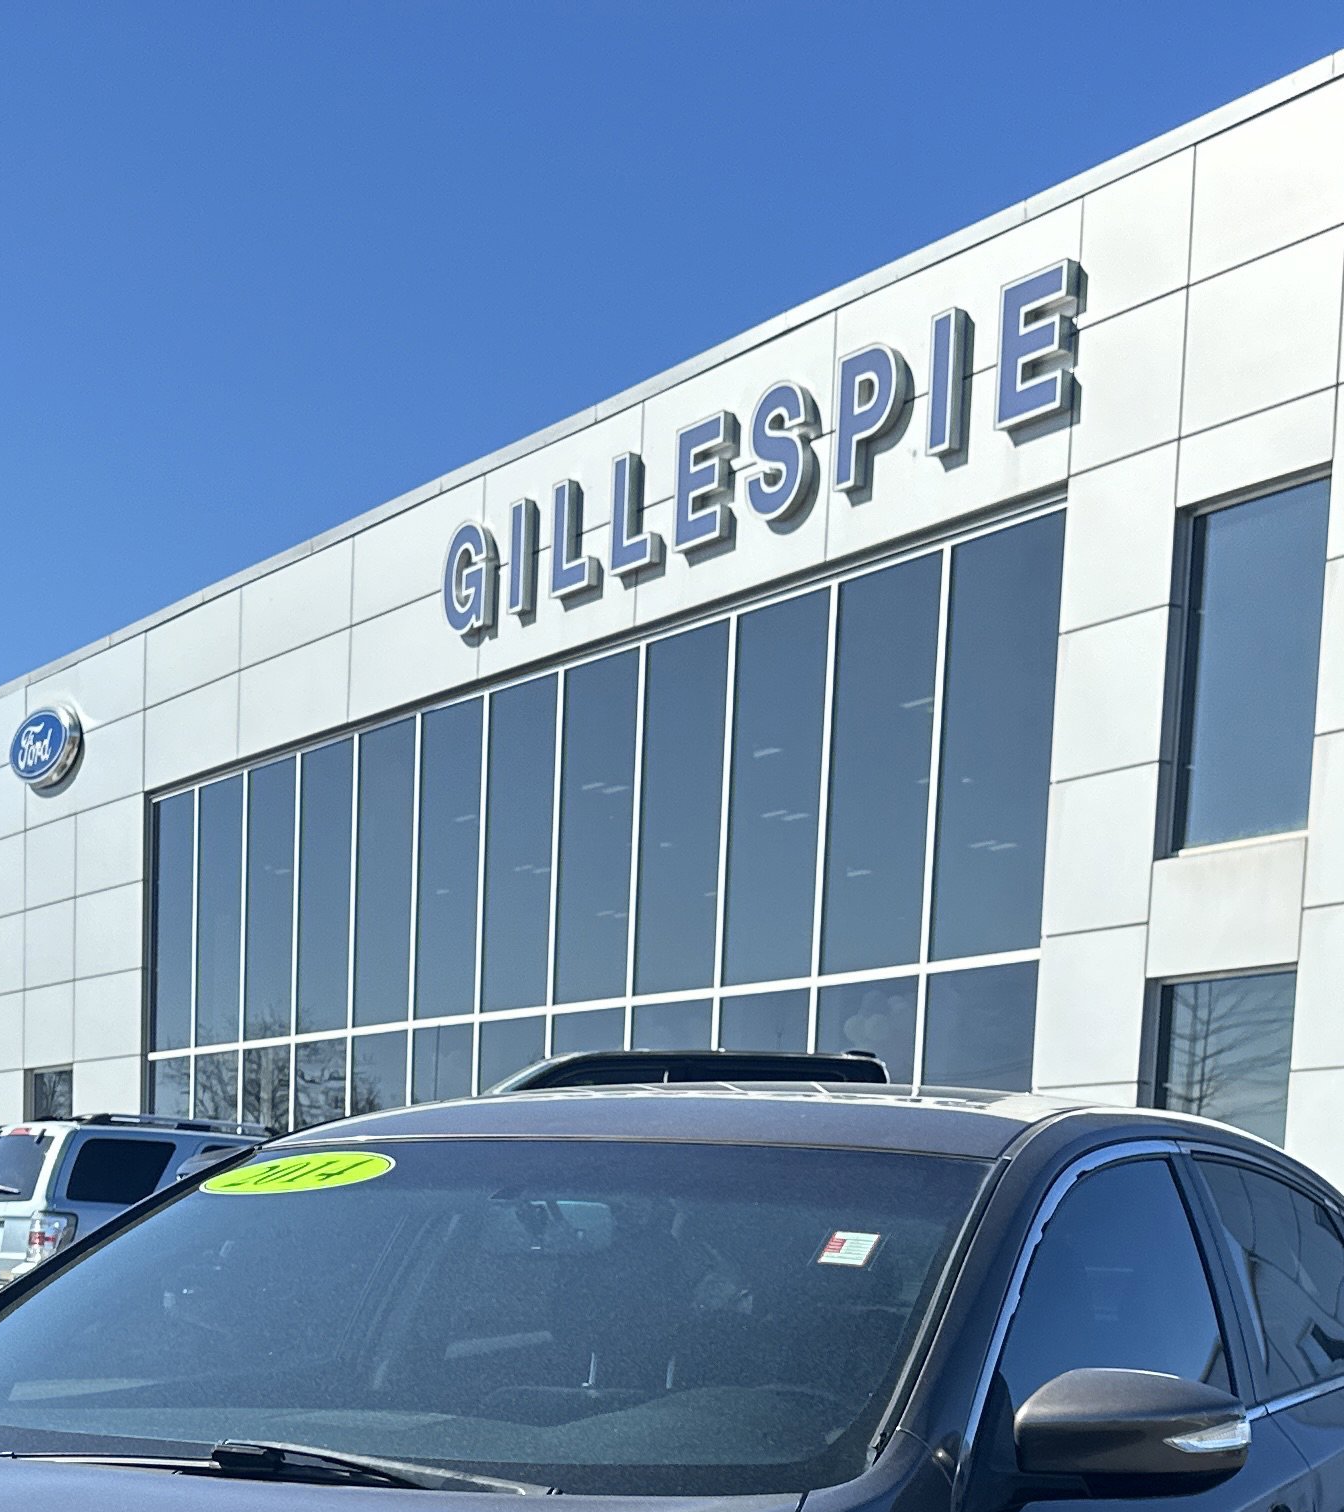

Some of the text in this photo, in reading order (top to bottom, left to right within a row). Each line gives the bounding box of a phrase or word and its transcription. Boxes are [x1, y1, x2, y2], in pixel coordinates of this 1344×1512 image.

[441, 258, 1087, 634] GILLESPIE
[18, 722, 53, 770] Ford
[220, 1158, 376, 1188] 2014
